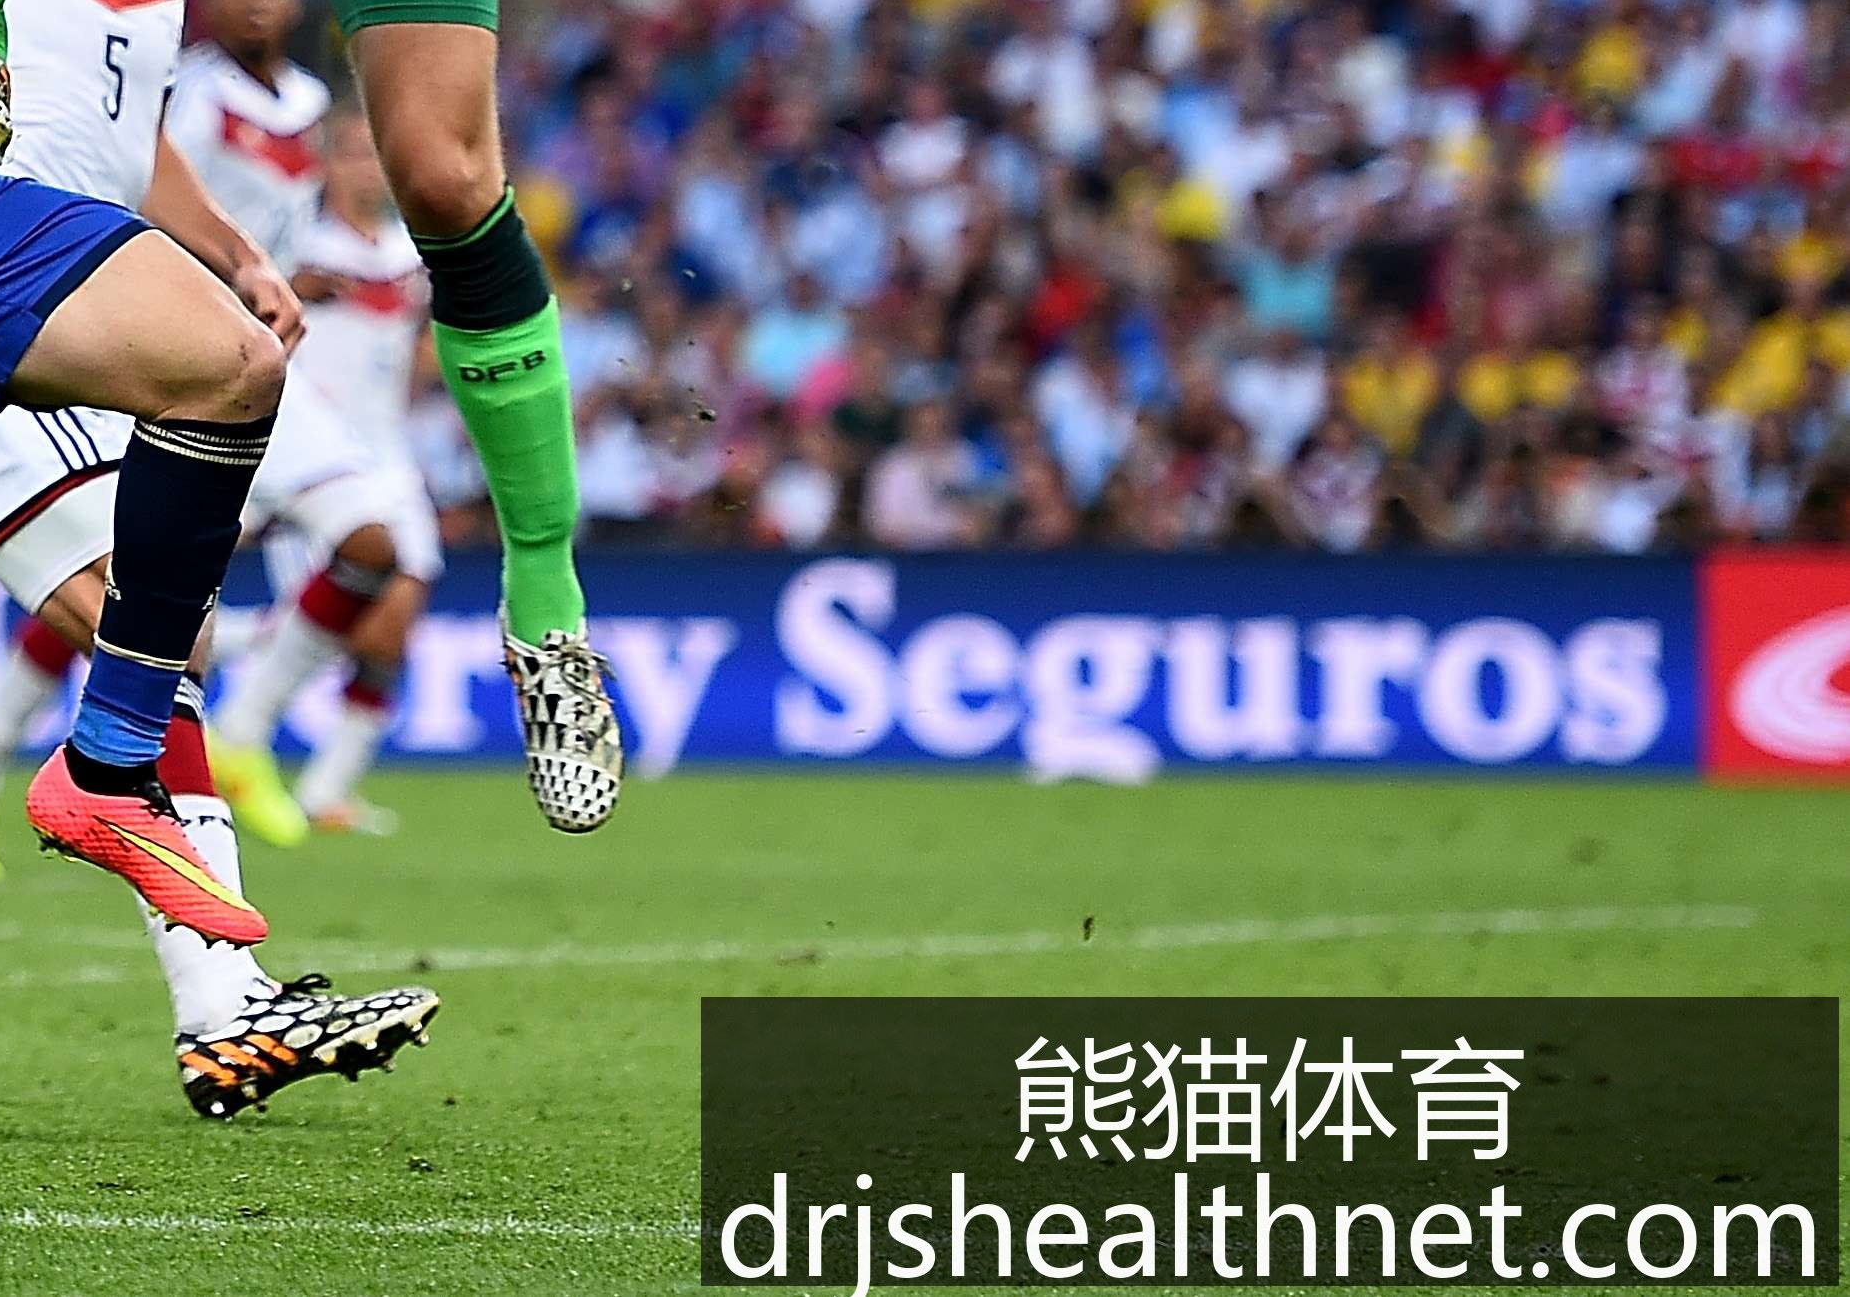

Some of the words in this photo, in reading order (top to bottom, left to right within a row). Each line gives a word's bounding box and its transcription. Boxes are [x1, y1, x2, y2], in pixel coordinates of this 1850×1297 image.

[102, 34, 128, 121] 5
[459, 350, 547, 383] DFB
[774, 558, 1671, 785] Seguros
